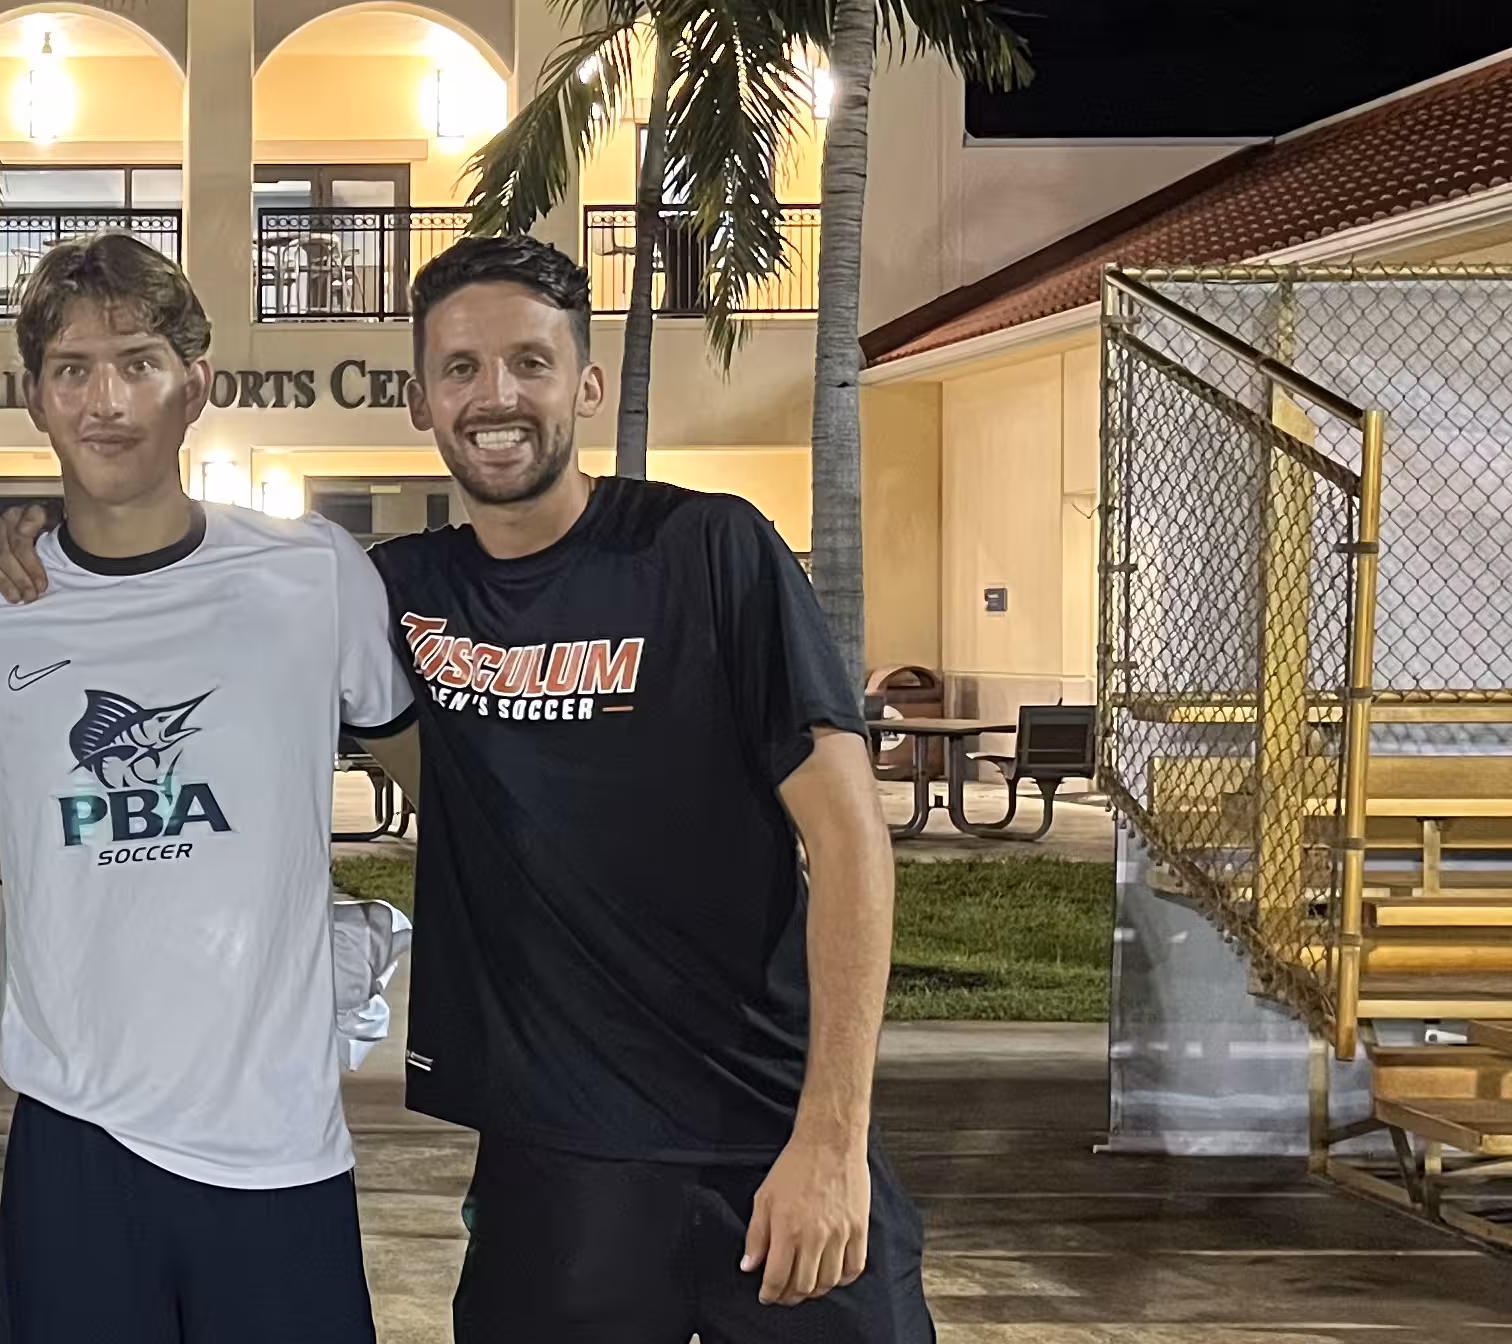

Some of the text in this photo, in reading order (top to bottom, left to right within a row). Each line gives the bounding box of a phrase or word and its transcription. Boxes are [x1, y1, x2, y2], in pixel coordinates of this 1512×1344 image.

[401, 612, 644, 698] TUSCULUM
[498, 697, 594, 721] SOCCER
[58, 782, 232, 847] PBA
[97, 843, 193, 866] SOCCER
